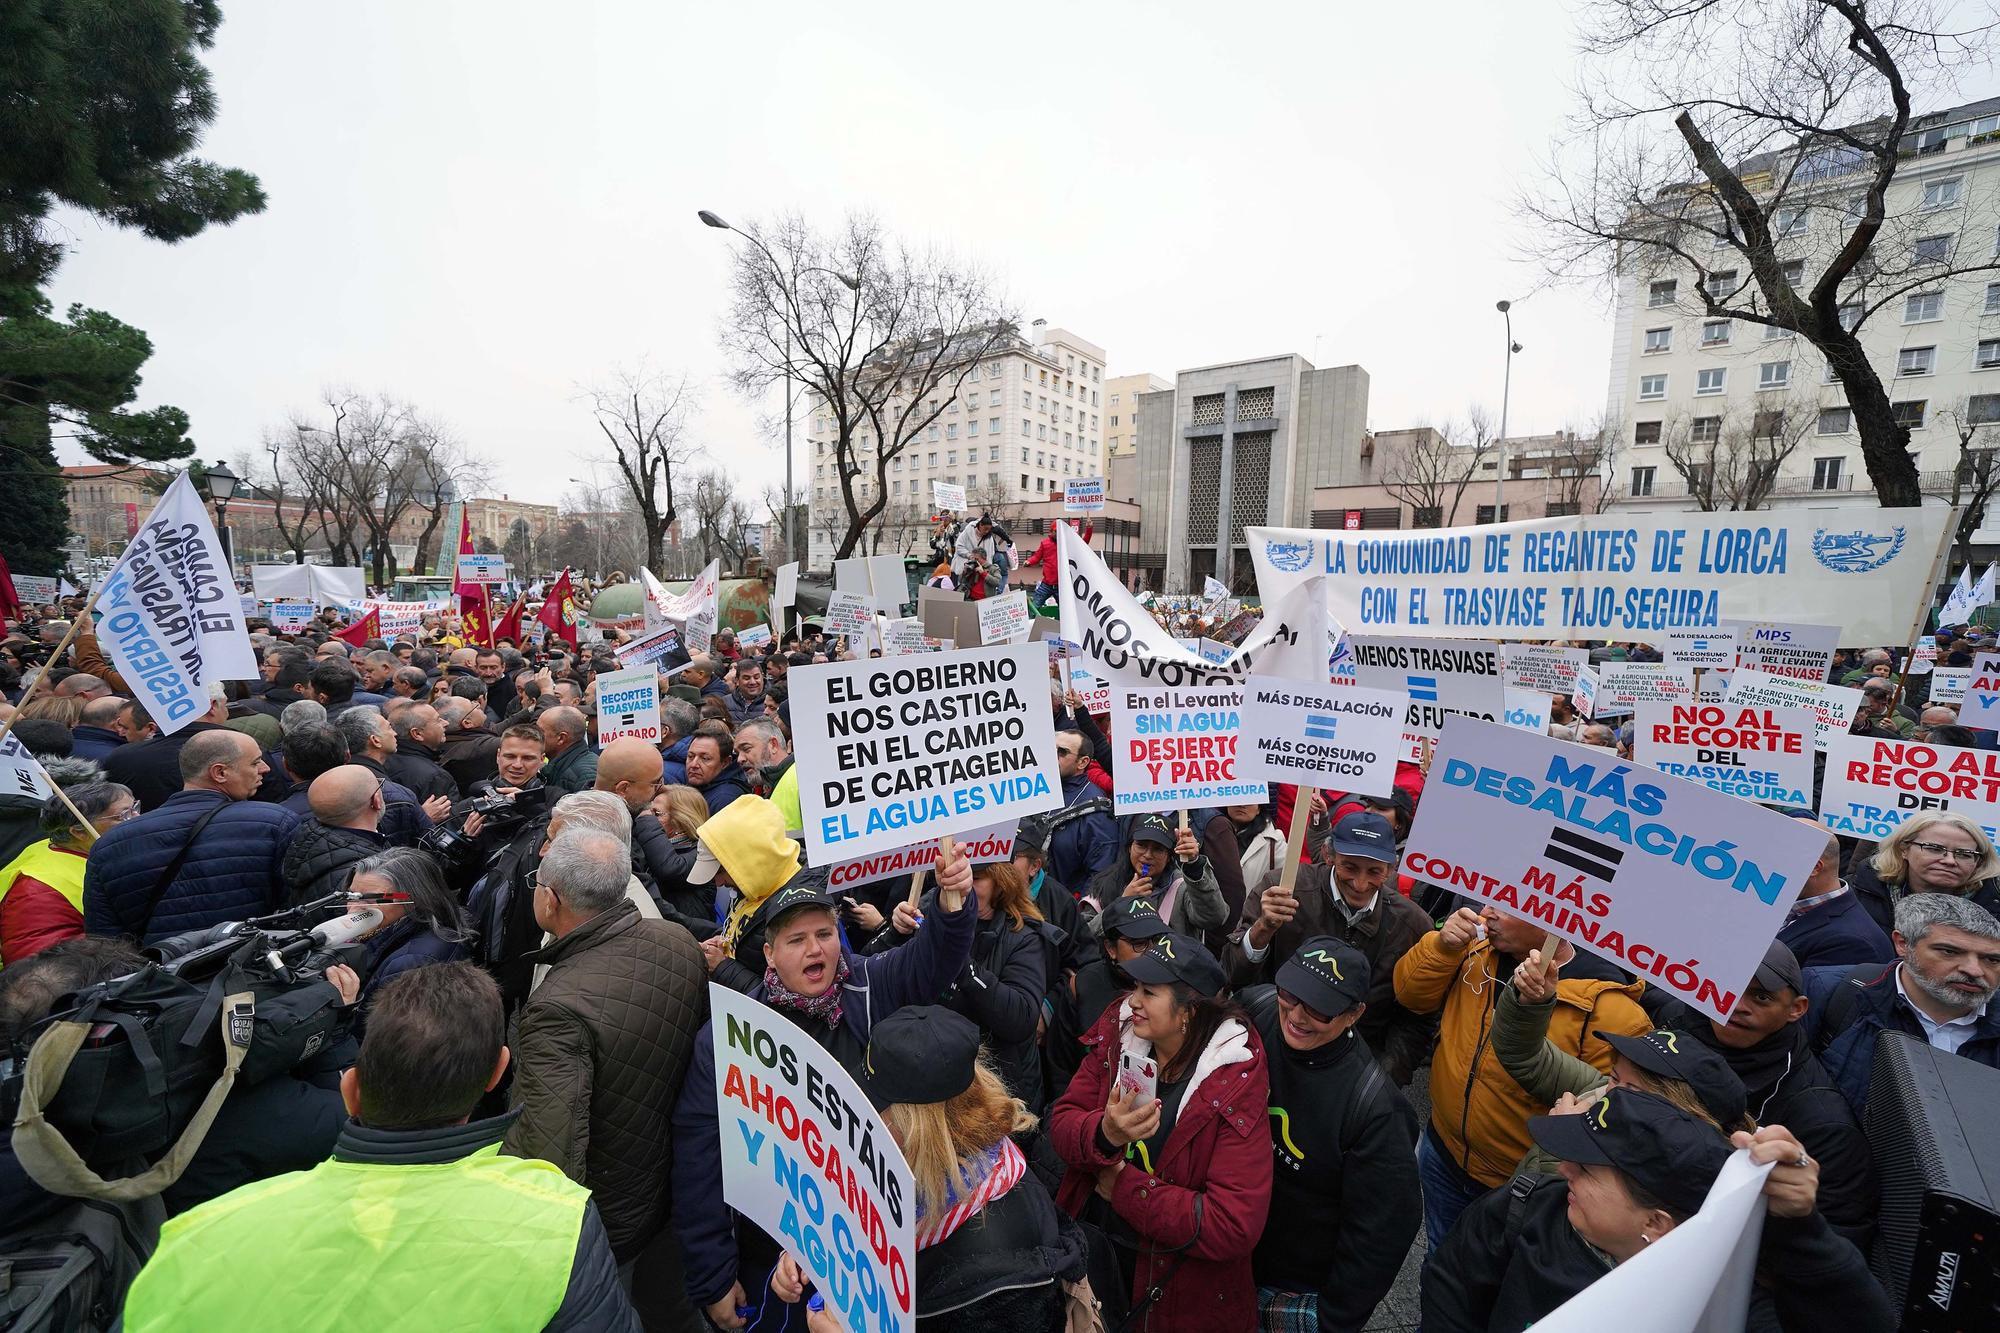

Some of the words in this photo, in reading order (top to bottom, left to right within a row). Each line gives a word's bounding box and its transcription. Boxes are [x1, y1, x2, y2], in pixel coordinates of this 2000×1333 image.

[1079, 495, 1103, 503] MUERE
[1347, 519, 1358, 527] 80
[1326, 539, 1345, 574] LA
[1358, 536, 1472, 574] COMUNIDAD
[1484, 534, 1510, 573] DE
[1523, 529, 1637, 573] REGANTES
[1652, 529, 1686, 573] DE
[1699, 527, 1787, 574] LORCA
[1361, 587, 1398, 624] CON
[1409, 588, 1429, 624] EL
[1443, 587, 1547, 626] TRASVASE
[1562, 586, 1719, 631] TAJO-SEGURA
[382, 627, 419, 635] HOGANDO
[1755, 629, 1792, 642] MPS
[1355, 645, 1409, 669] MENOS
[1410, 649, 1498, 676] TRASVASE
[1759, 648, 1828, 659] AGRICULTURA
[1782, 657, 1825, 667] LEVANTE
[826, 676, 863, 704] EL
[869, 658, 1017, 697] GOBIERNO
[1762, 665, 1824, 681] TRASVASE
[1769, 678, 1826, 693] proexport
[602, 688, 653, 705] RECORTES
[602, 699, 653, 715] TRASVASE
[1126, 693, 1152, 709] En
[1154, 692, 1169, 708] el
[1257, 690, 1290, 705] MÁS
[1293, 695, 1393, 718] DESALACIÓN
[1758, 688, 1816, 705] AGRICULTURA
[1833, 703, 1844, 711] LA
[1979, 695, 2000, 709] Y
[826, 706, 895, 738] NOS
[900, 688, 1027, 726] CASTIGA,
[1136, 714, 1172, 734] SIN
[1178, 711, 1239, 732] AGUA
[1673, 705, 1725, 727] NO
[1735, 708, 1781, 731] AL
[837, 740, 878, 771] EN
[884, 735, 919, 763] EL
[924, 717, 1024, 755] CAMPO
[1258, 737, 1291, 751] MÁS
[1295, 743, 1376, 764] CONSUMO
[1653, 725, 1802, 754] RECORTE
[1265, 753, 1364, 776] ENERGÉTICO
[1697, 749, 1746, 766] DEL
[1873, 741, 1938, 768] NO
[1948, 752, 2000, 778] AL
[823, 777, 866, 809] DE
[871, 745, 1038, 798] CARTAGENA
[1146, 763, 1163, 785] Y
[1545, 754, 1667, 817] MÁS
[1656, 762, 1779, 786] TRASVASE
[1847, 761, 2000, 803] RECORT
[1116, 789, 1178, 805] TRASVASE
[1180, 784, 1267, 799] TAJO-SEGURA
[821, 813, 859, 844] EL
[866, 794, 949, 835] AGUA
[953, 786, 986, 814] ES
[989, 772, 1051, 805] VIDA
[1442, 758, 1787, 906] DESALACIÓN
[1521, 866, 1613, 918] MÁS
[350, 912, 374, 923] REUTERS
[1405, 852, 1737, 1016] CONTAMINACIÓN
[727, 1013, 799, 1087] NOS
[806, 1062, 903, 1229] ESTÁIS
[723, 1063, 910, 1314] AHOGANDO
[737, 1117, 766, 1167] Y
[773, 1143, 825, 1226] NO
[832, 1213, 900, 1333] CON
[779, 1200, 866, 1333] AGUA
